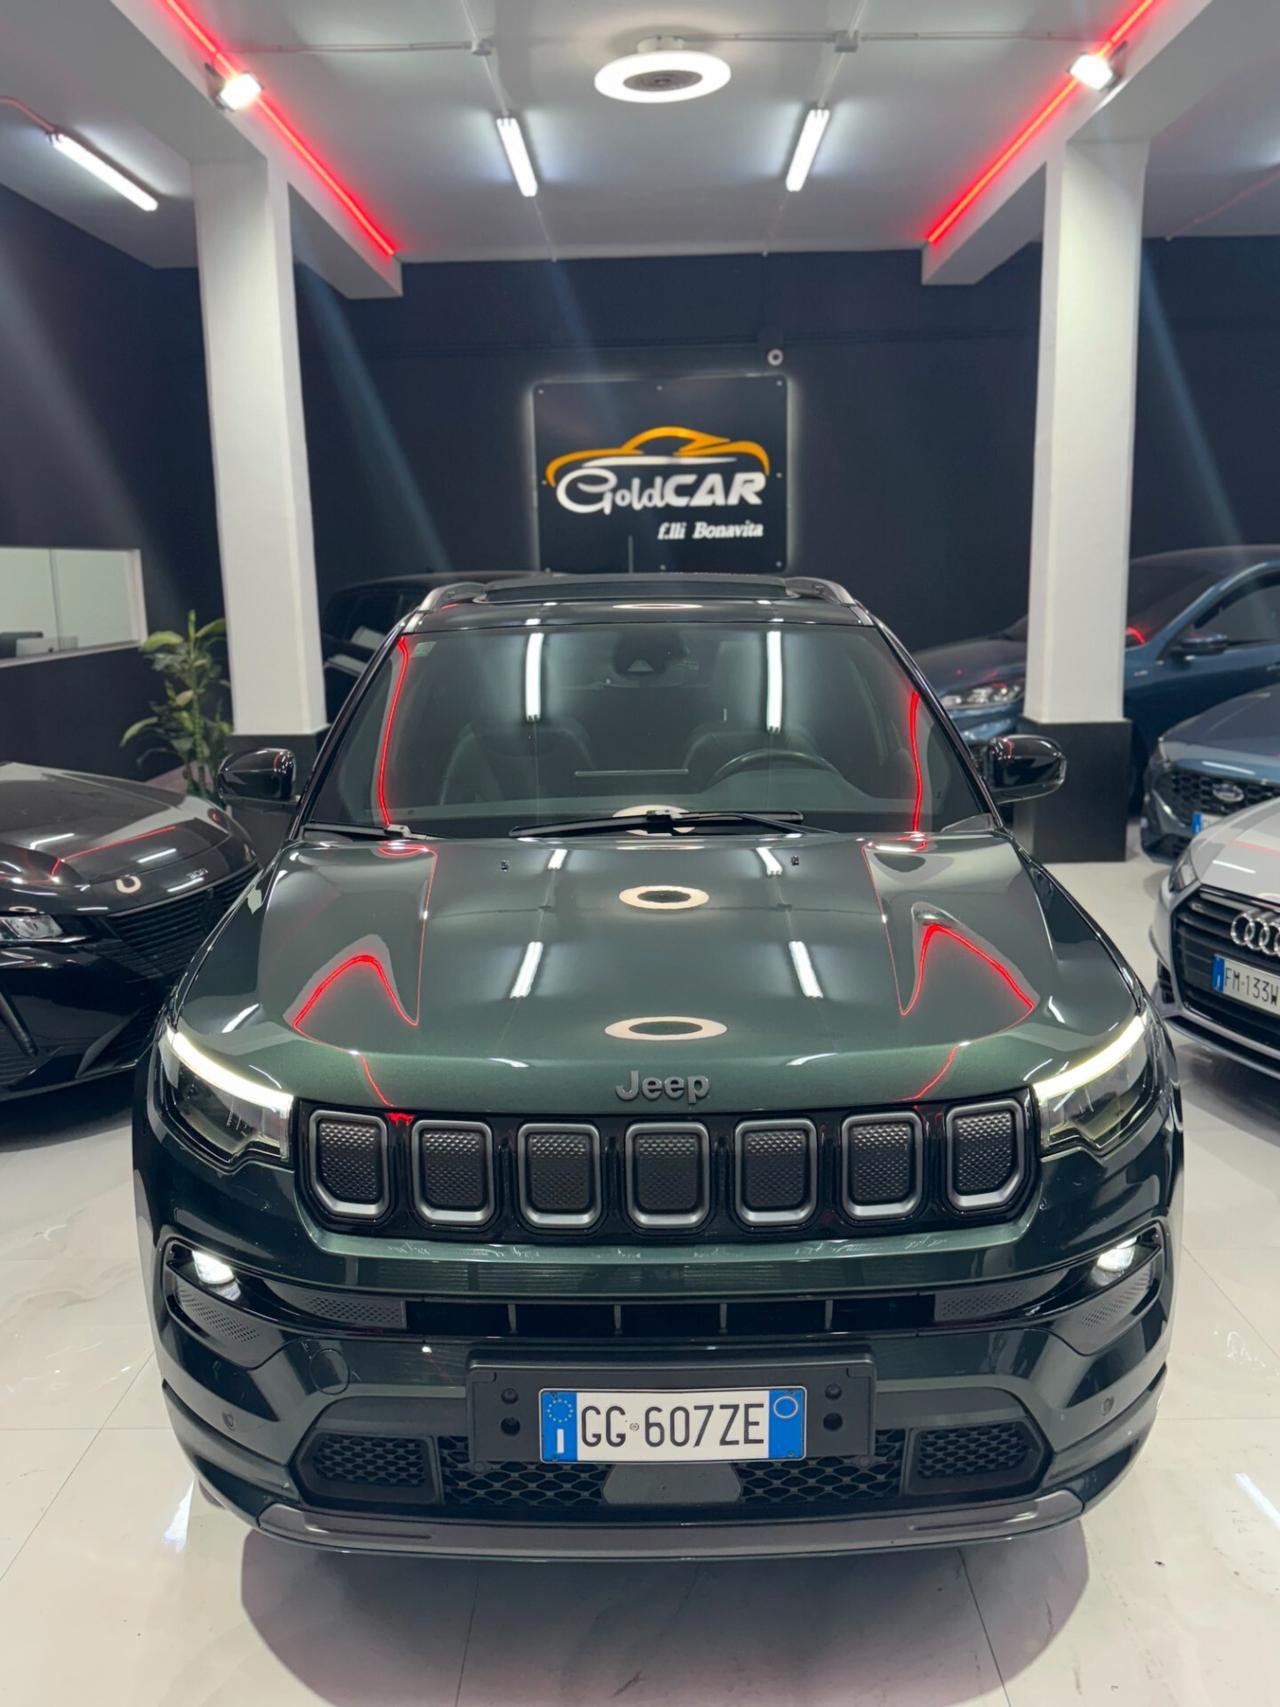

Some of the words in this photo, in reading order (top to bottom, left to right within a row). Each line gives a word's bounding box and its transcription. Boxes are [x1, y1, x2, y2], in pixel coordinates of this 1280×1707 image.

[556, 467, 767, 515] GoldCAR
[692, 519, 764, 539] Bonavita
[1225, 966, 1241, 993] FM
[1246, 974, 1279, 1007] 133W
[615, 1070, 711, 1105] Jeep
[581, 1405, 627, 1448] GG
[644, 1403, 765, 1448] 607ZE
